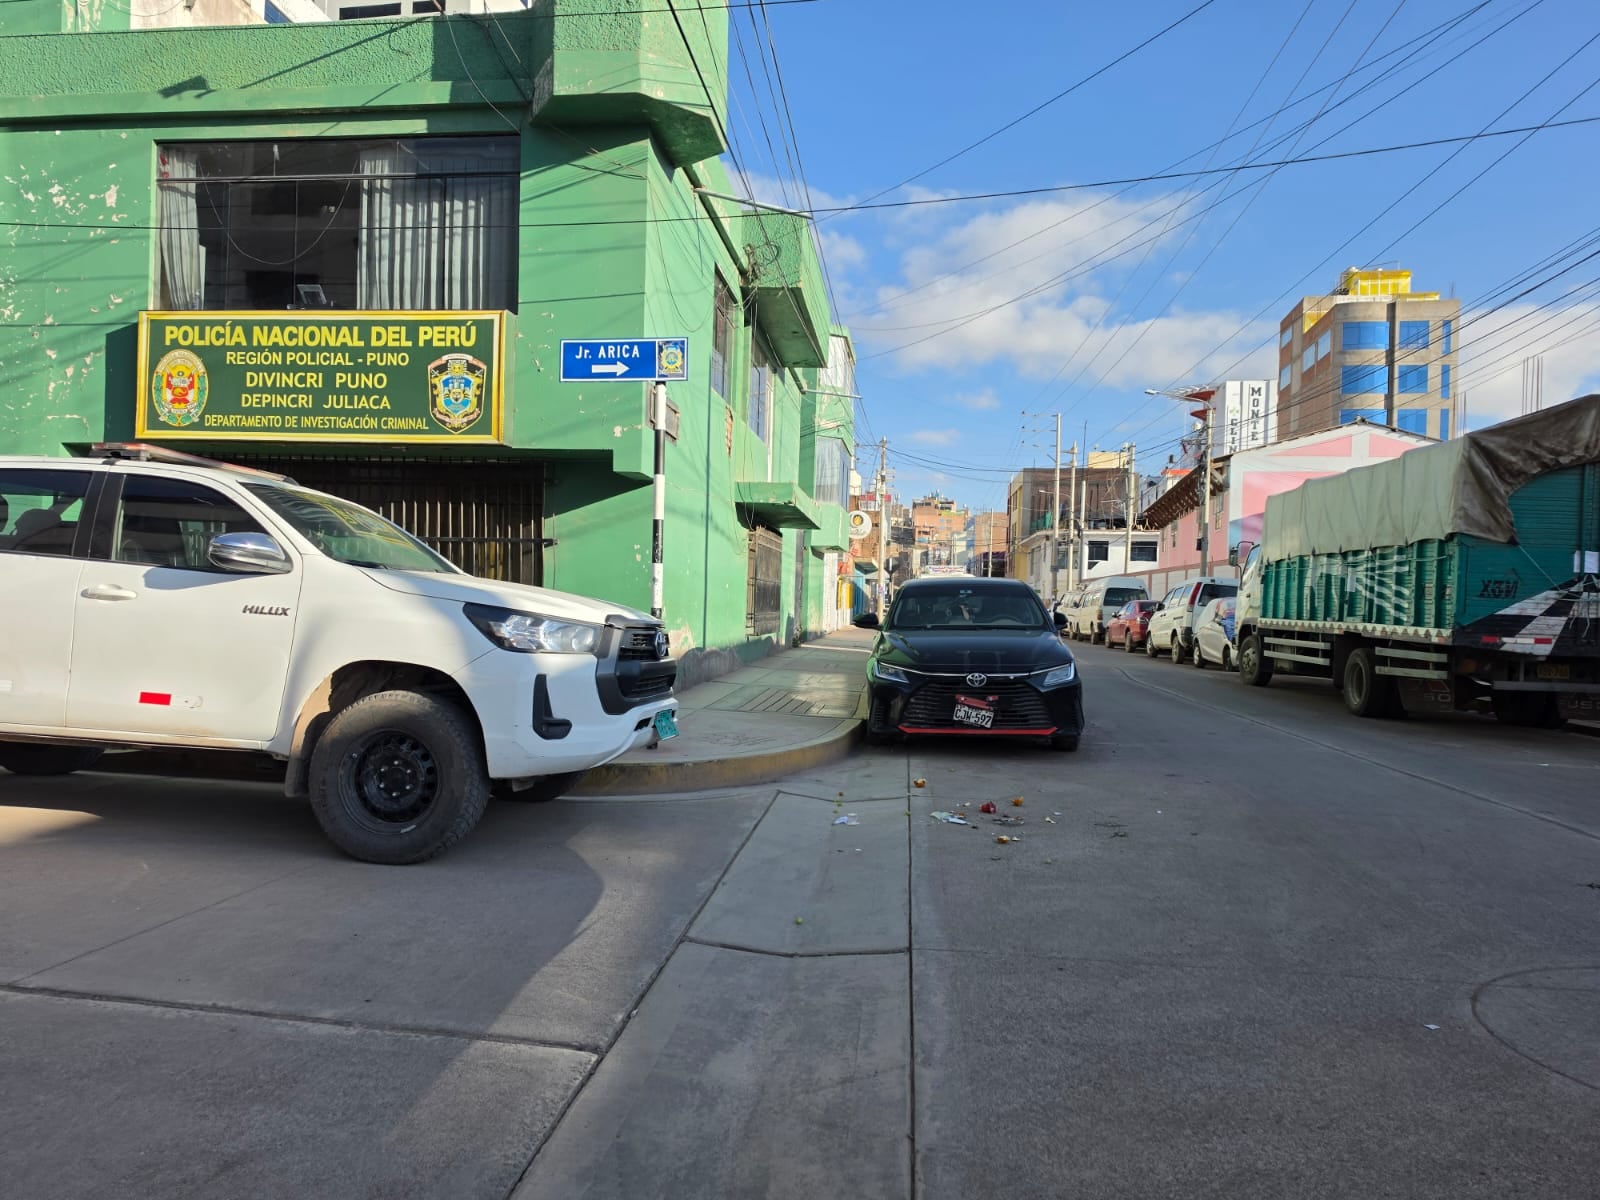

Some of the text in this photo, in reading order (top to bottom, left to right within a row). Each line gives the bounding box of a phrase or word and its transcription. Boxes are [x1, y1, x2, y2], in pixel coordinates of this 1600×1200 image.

[164, 321, 477, 348] POLICÍA NACIONAL DEL PERÚ
[226, 349, 282, 366] REGIÓN
[286, 352, 354, 366] POLICIAL
[366, 352, 410, 366] PUNO
[575, 345, 640, 359] Jr. ARICA
[246, 371, 388, 389] DIVINCRI PUNO
[241, 393, 391, 410] DEPINCRI JULIACA
[204, 414, 429, 430] DEPARTAMENTO DE INVESTIGACIÓN CRIMINAL
[1250, 386, 1262, 441] MONTE
[242, 604, 290, 616] HILUX
